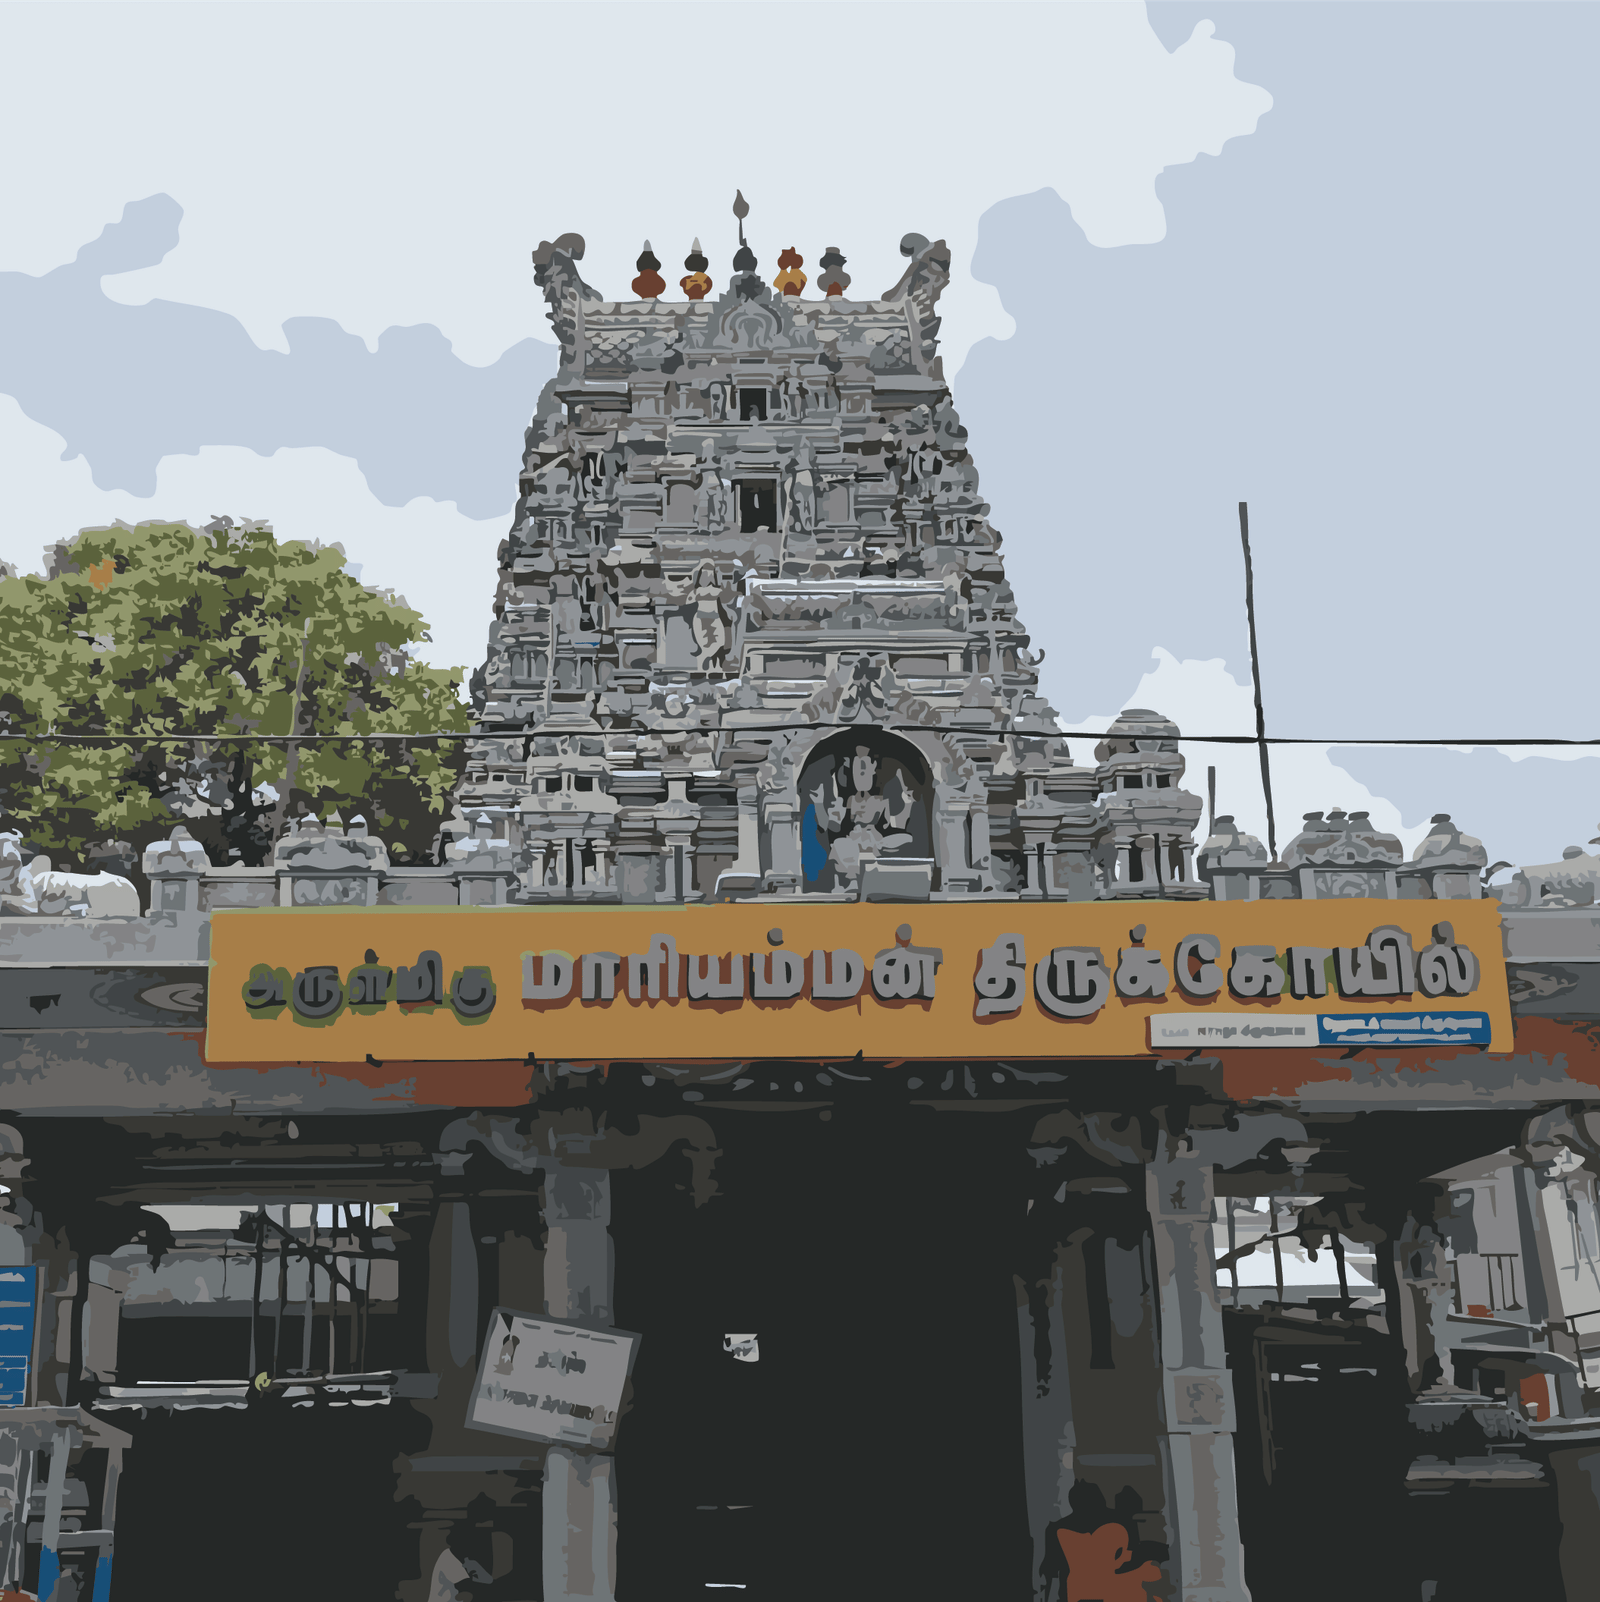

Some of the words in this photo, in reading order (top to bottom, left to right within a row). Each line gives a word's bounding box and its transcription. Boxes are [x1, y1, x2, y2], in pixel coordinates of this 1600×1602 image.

[244, 948, 498, 1020] அருள்மிகு
[520, 922, 944, 1003] மாரியம்மன்
[973, 921, 1481, 1019] திருக்கோயில்
